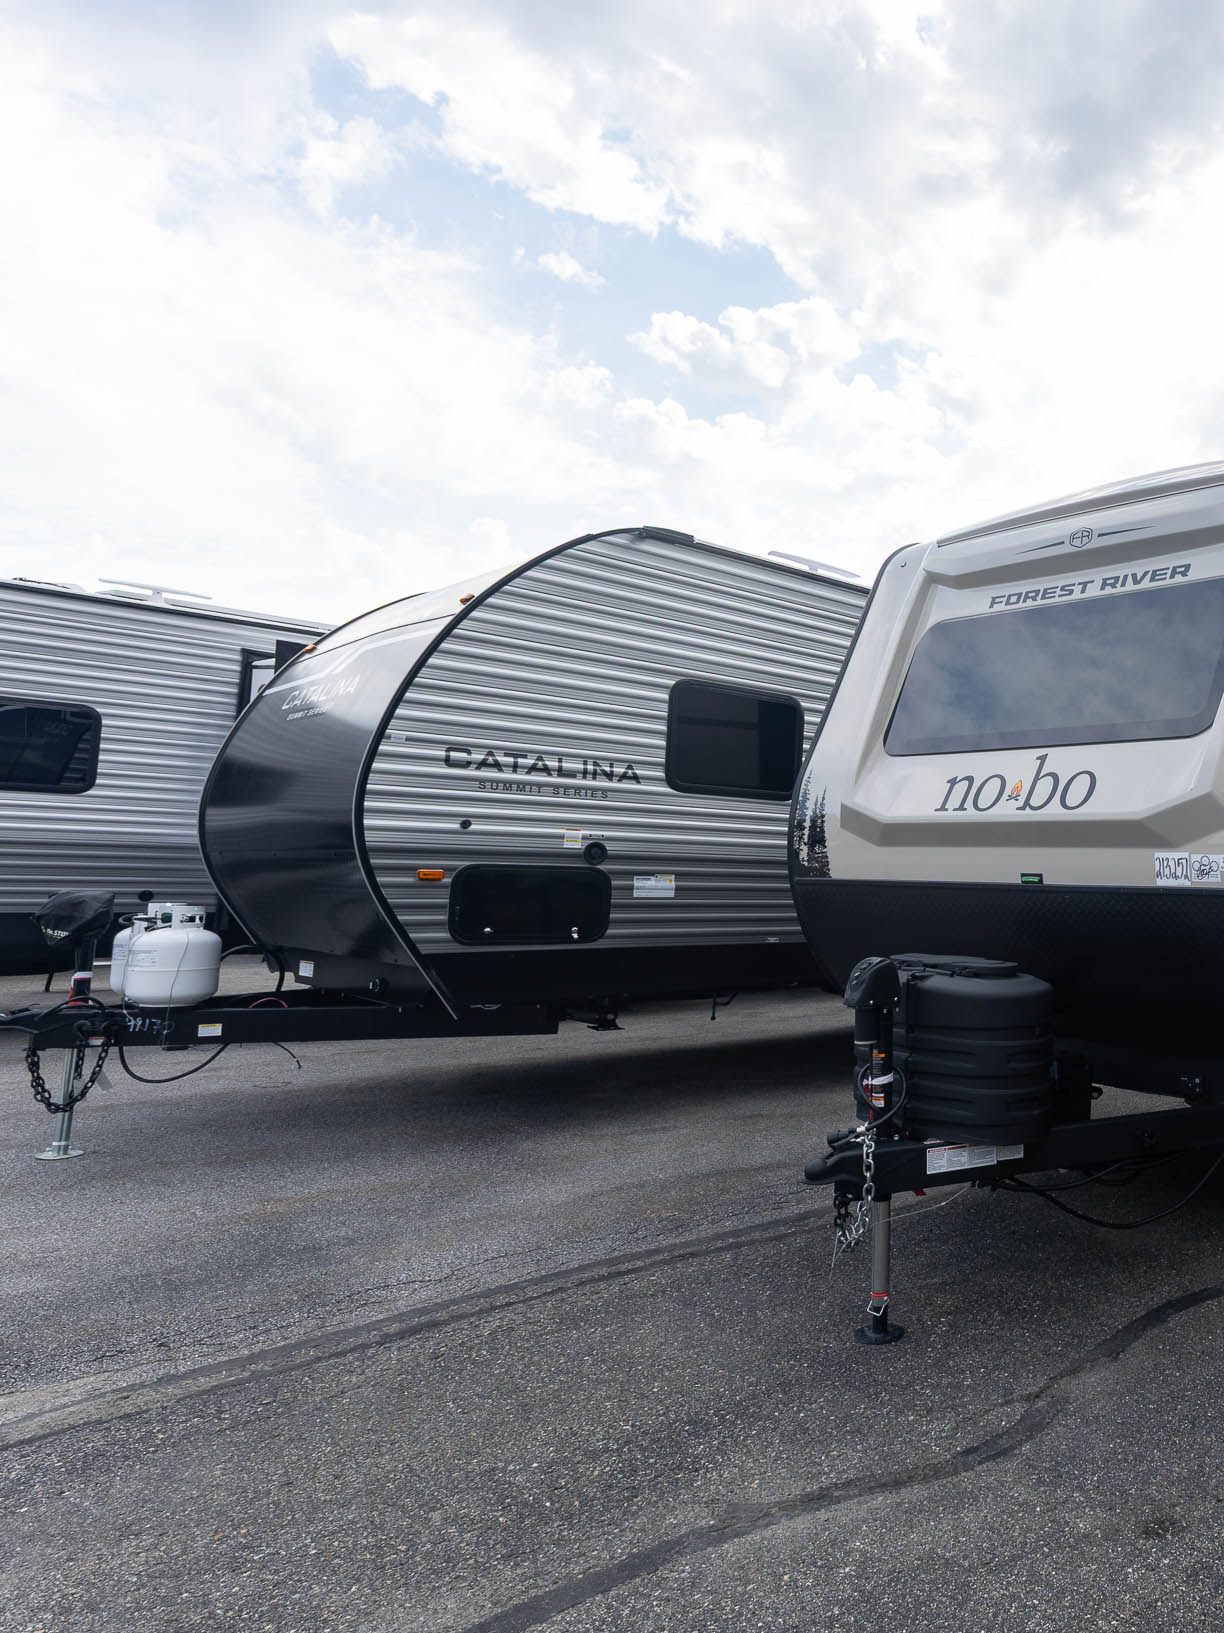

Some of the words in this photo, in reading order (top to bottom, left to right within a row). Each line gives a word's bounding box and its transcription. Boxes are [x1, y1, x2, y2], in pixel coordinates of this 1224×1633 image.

[988, 581, 1095, 609] FOREST
[1100, 563, 1192, 591] RIVER
[281, 674, 361, 710] CATALINA
[444, 746, 641, 784] CATALINA
[478, 781, 544, 794] SUMMIT
[552, 786, 609, 799] SERIES
